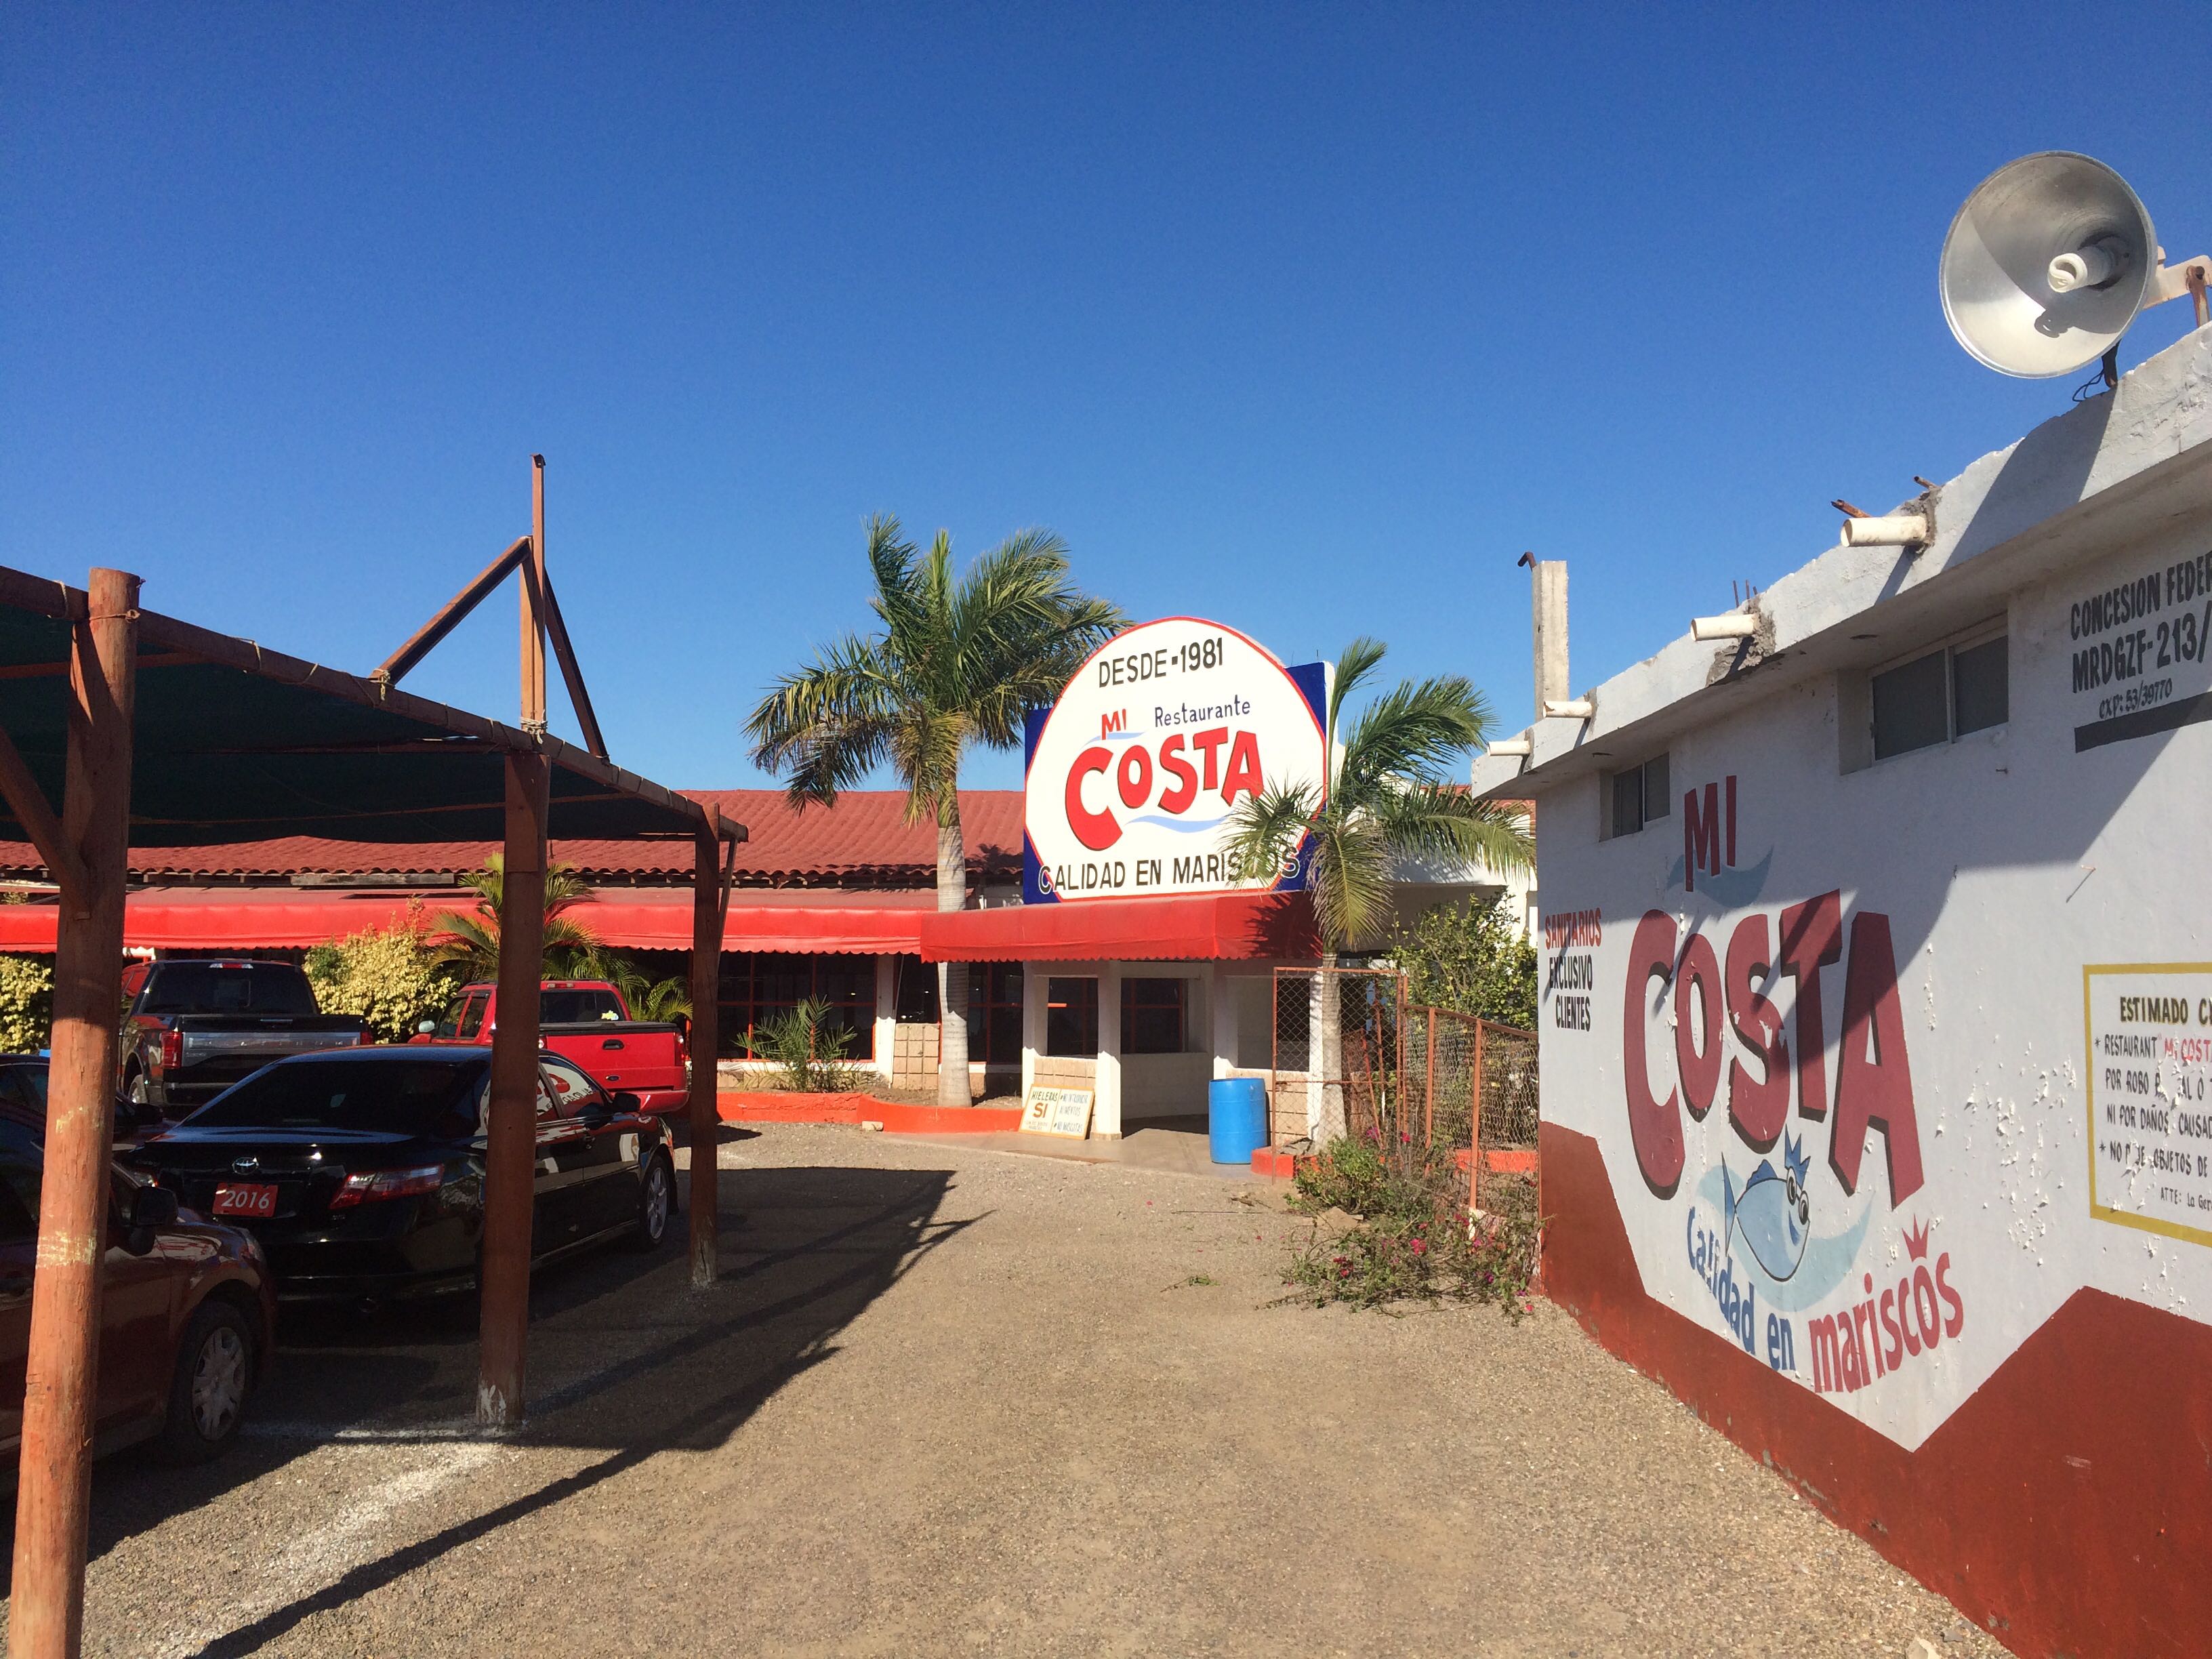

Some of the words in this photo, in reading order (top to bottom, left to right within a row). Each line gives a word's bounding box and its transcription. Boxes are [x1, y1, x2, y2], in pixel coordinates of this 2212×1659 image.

[2070, 573, 2160, 640] CONCESION
[1101, 709, 1127, 740] MI
[1155, 695, 1250, 727] Restaurante
[1065, 726, 1264, 851] COSTA
[1684, 776, 1737, 892] MI
[1038, 861, 1126, 895] CALIDAD
[1136, 859, 1161, 886] EN
[1545, 907, 1602, 949] SANITARIOS
[1549, 954, 1593, 991] EXCLUSIVO
[1556, 994, 1591, 1031] CLIENTES
[2120, 997, 2188, 1024] ESTIMADO
[1624, 888, 1925, 1210] COSTA
[2105, 1034, 2157, 1058] RESTAURANT
[2181, 1038, 2212, 1062] COST
[2106, 1068, 2121, 1090] POR
[2127, 1070, 2149, 1094] ROBO
[1033, 1103, 1048, 1118] SI
[2107, 1105, 2116, 1124] NI
[2120, 1105, 2135, 1128] POR
[2141, 1104, 2169, 1133] DAÑOS
[2110, 1141, 2122, 1162] NO
[2154, 1149, 2192, 1176] OBJETOS
[2198, 1155, 2207, 1178] DE
[222, 1191, 270, 1210] 2016
[2198, 1195, 2212, 1212] Ger
[1767, 1313, 1797, 1371] en
[1808, 1252, 1964, 1394] mariscos
